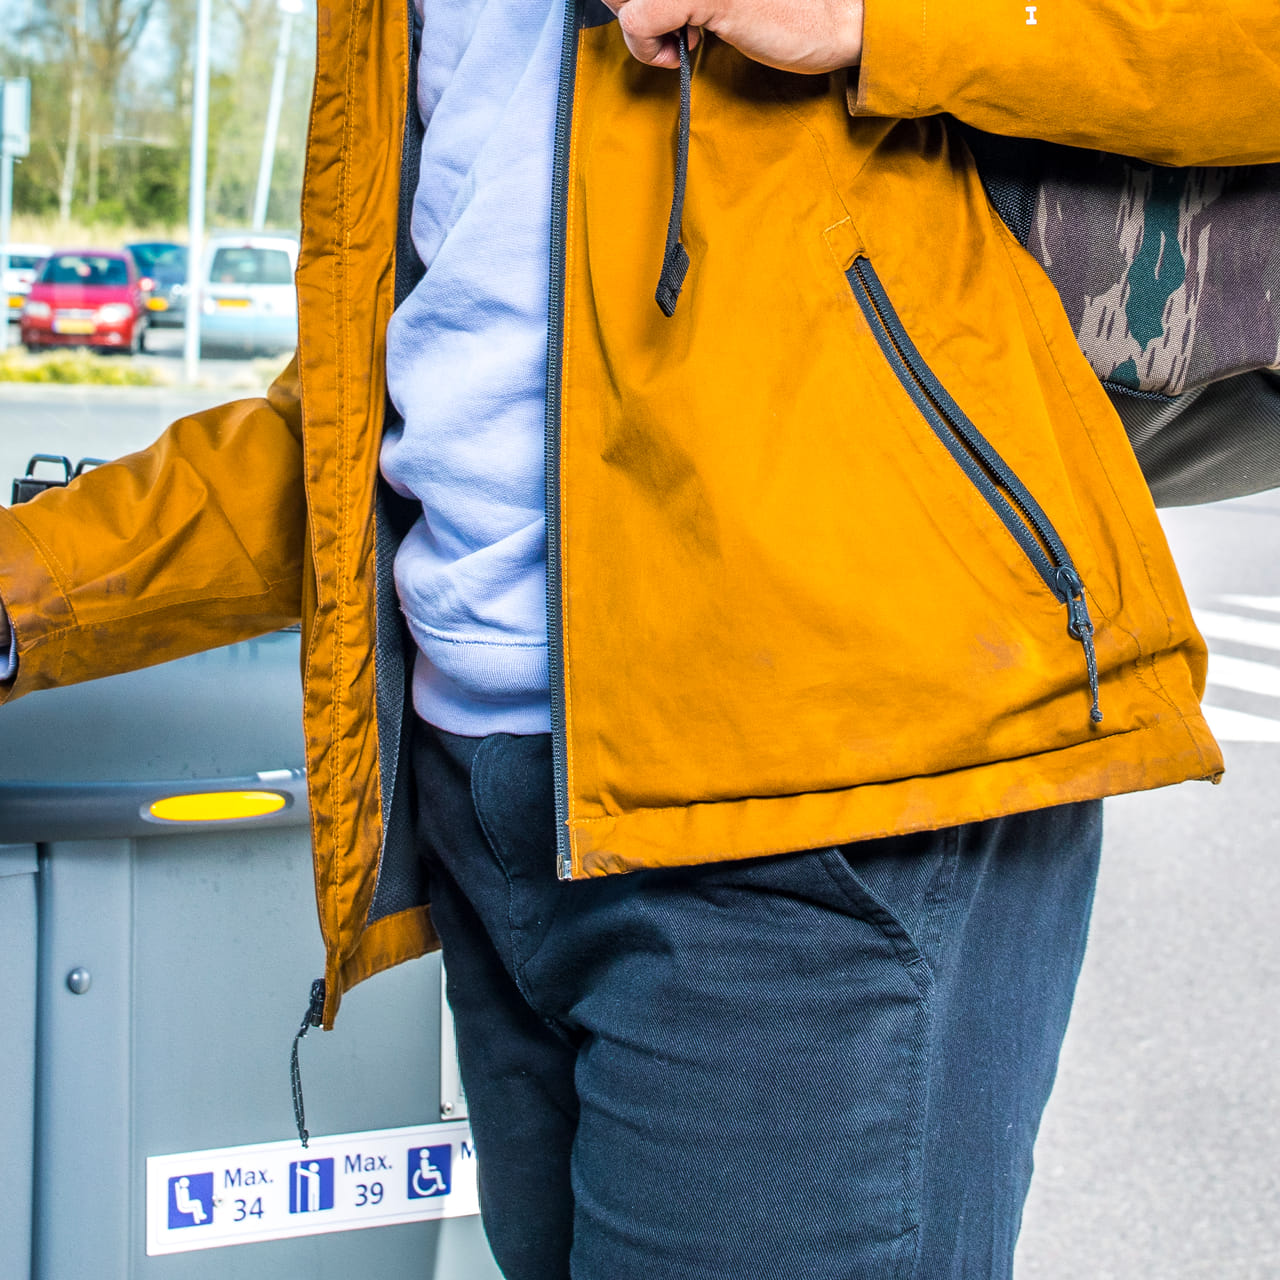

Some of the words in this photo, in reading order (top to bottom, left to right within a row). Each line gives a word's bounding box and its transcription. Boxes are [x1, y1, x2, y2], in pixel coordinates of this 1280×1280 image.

[344, 1154, 393, 1175] Max.
[223, 1168, 274, 1189] Max.
[354, 1182, 384, 1206] 39
[233, 1197, 264, 1222] 34
